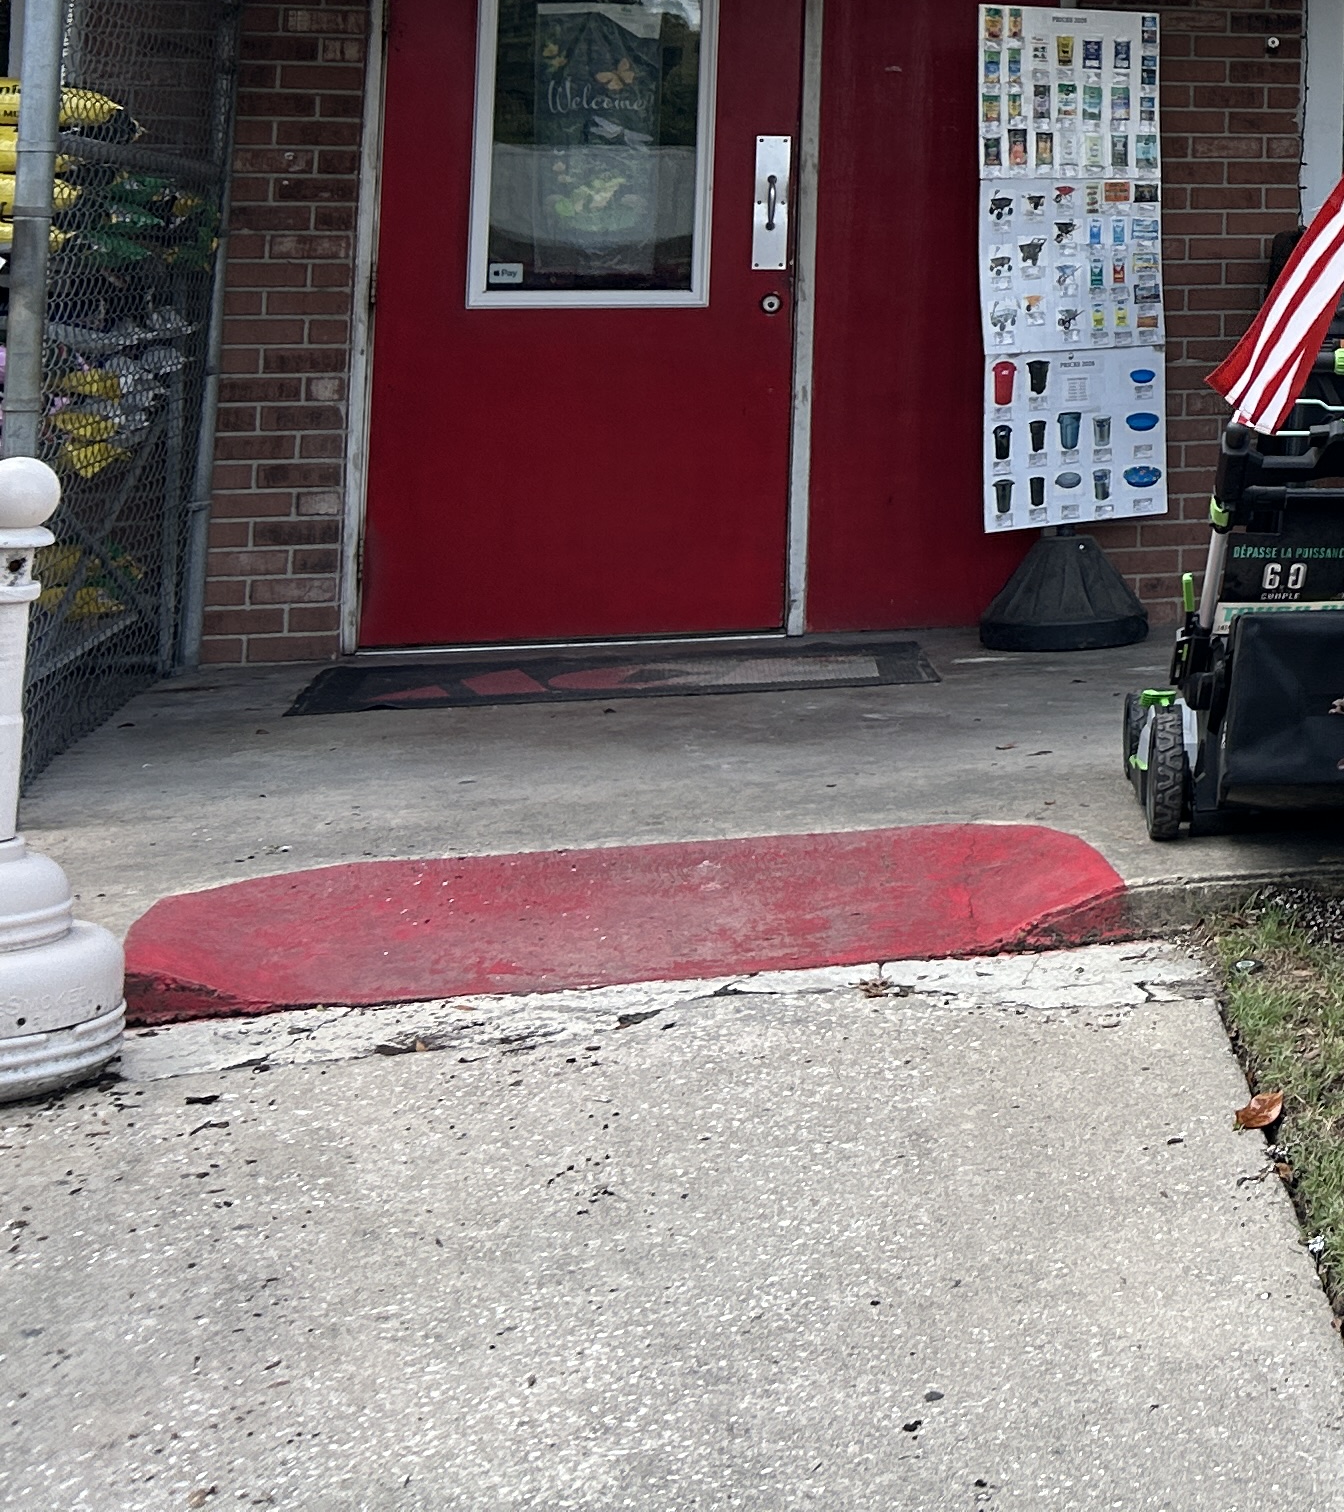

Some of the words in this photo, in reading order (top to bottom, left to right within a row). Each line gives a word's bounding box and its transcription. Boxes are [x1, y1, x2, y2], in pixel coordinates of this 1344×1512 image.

[547, 76, 648, 114] Welcome
[501, 269, 518, 278] Pay
[1233, 544, 1278, 559] DÉPASSE
[1280, 547, 1292, 559] LA
